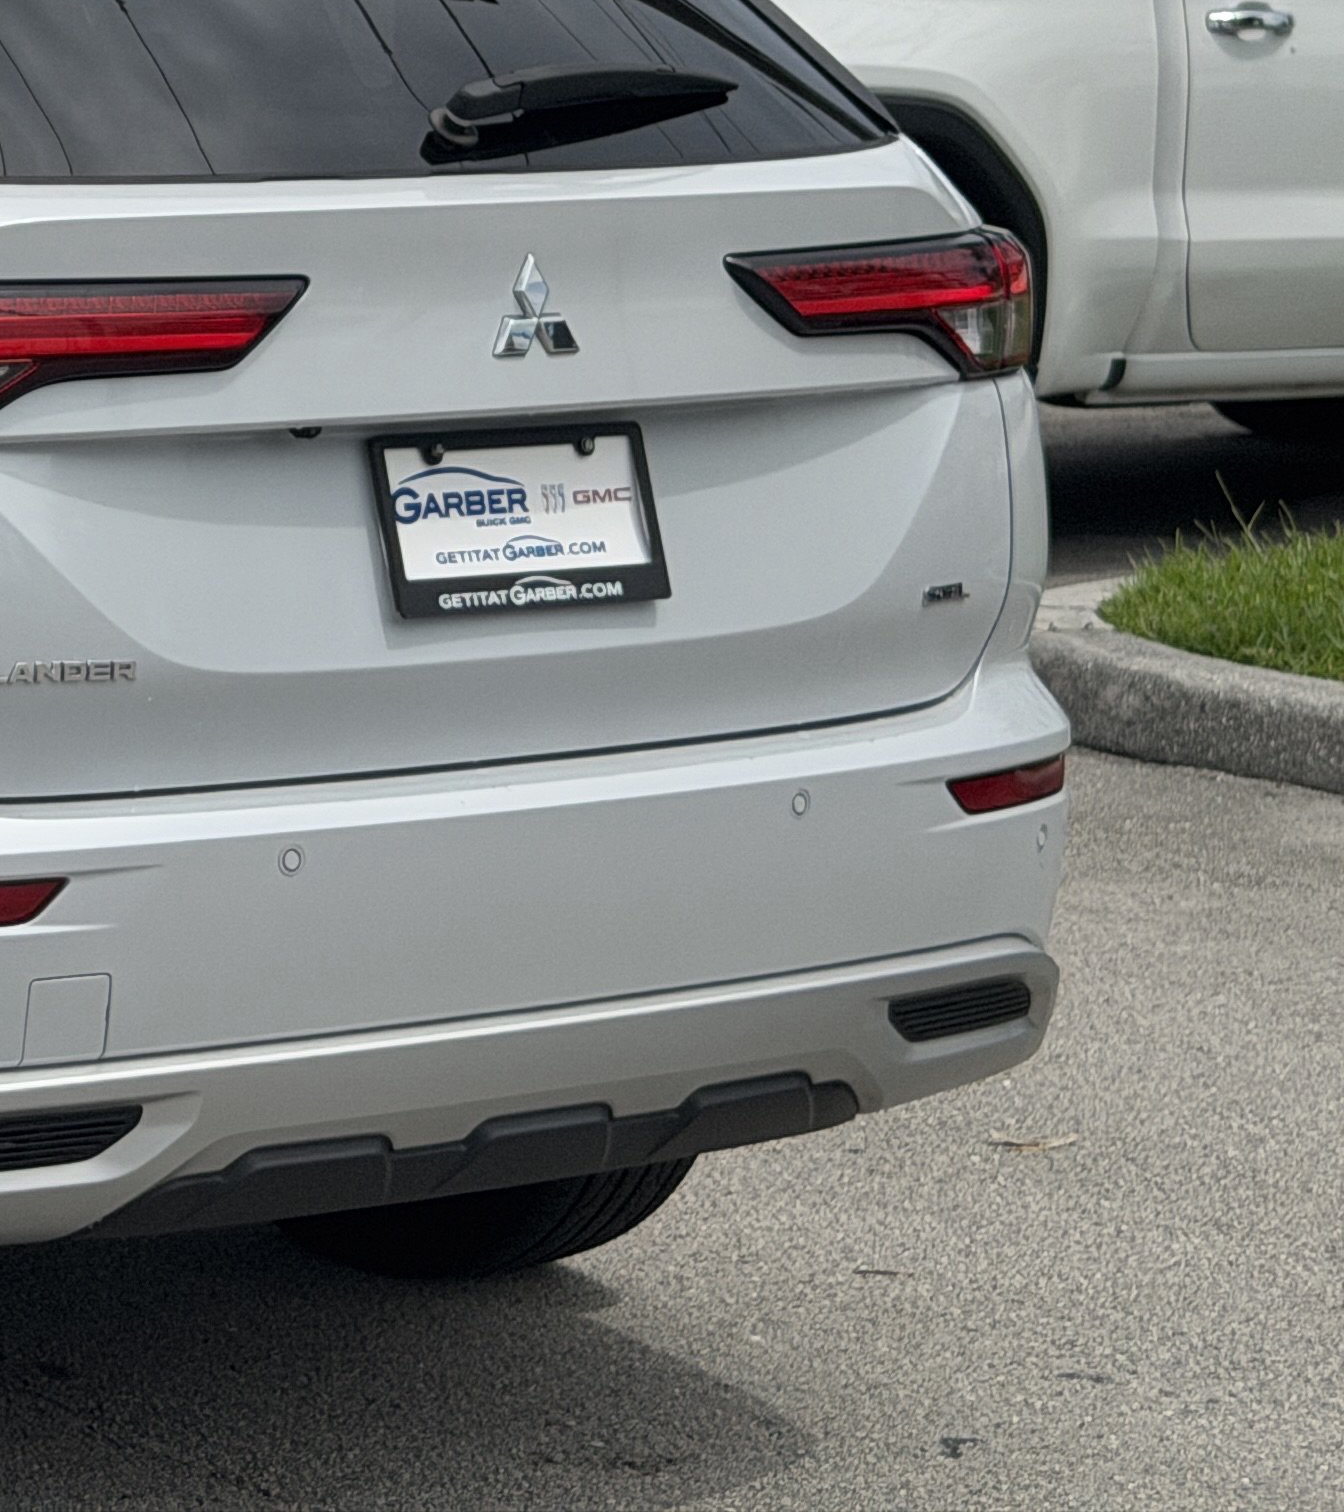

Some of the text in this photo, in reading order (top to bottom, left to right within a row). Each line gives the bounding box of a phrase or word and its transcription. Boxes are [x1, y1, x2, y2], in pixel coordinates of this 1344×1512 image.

[572, 487, 633, 505] GMC
[392, 487, 530, 524] GARBER
[476, 515, 532, 527] BUICK GMC
